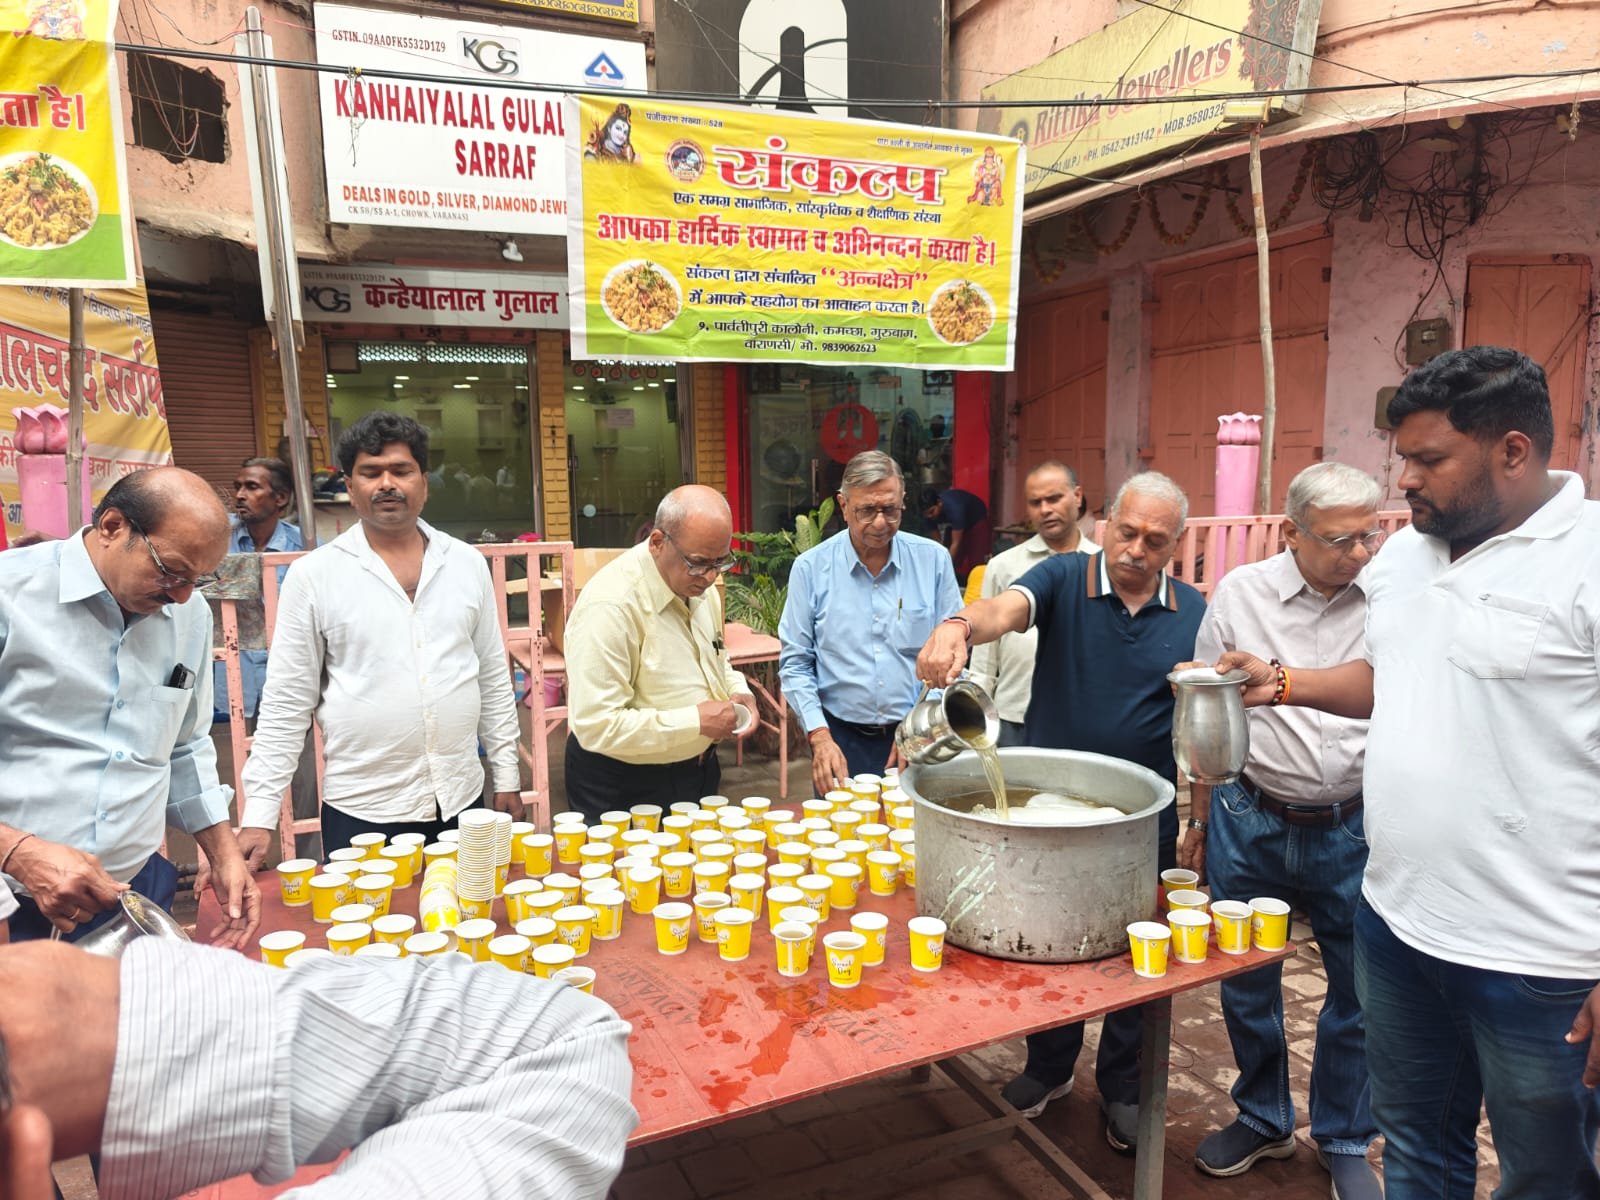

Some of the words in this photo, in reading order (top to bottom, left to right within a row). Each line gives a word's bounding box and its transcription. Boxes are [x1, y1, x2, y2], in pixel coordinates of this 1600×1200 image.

[462, 37, 519, 77] KGS
[1106, 37, 1233, 119] Jewellers
[334, 78, 495, 131] KANHAIYALAL
[455, 138, 536, 180] SARRAF
[714, 136, 946, 204] संकल्प
[343, 185, 381, 202] DEALS
[384, 188, 397, 204] IN
[399, 189, 435, 209] GOLD,
[437, 191, 481, 212] SILVER,
[482, 195, 538, 213] DIAMOND
[673, 191, 695, 205] एक
[698, 193, 731, 207] समग्र
[855, 207, 864, 217] व
[913, 208, 942, 224] संस्था
[598, 214, 671, 242] आपका
[677, 213, 742, 247] हार्दिक
[747, 224, 808, 252] स्वागत
[814, 229, 828, 252] व
[833, 226, 922, 258] अभिनन्दन
[928, 238, 971, 262] करता
[972, 235, 996, 266] है।
[685, 263, 730, 281] संकल्प
[734, 269, 760, 283] द्वारा
[764, 267, 816, 285] संचालित
[362, 278, 486, 312] कन्हैयालाल
[493, 289, 559, 321] गुलाल
[689, 288, 704, 304] में
[706, 291, 747, 305] आपके
[751, 292, 798, 308] सहयोग
[801, 297, 819, 310] का
[875, 300, 908, 314] करता
[822, 341, 877, 353] 9839062623
